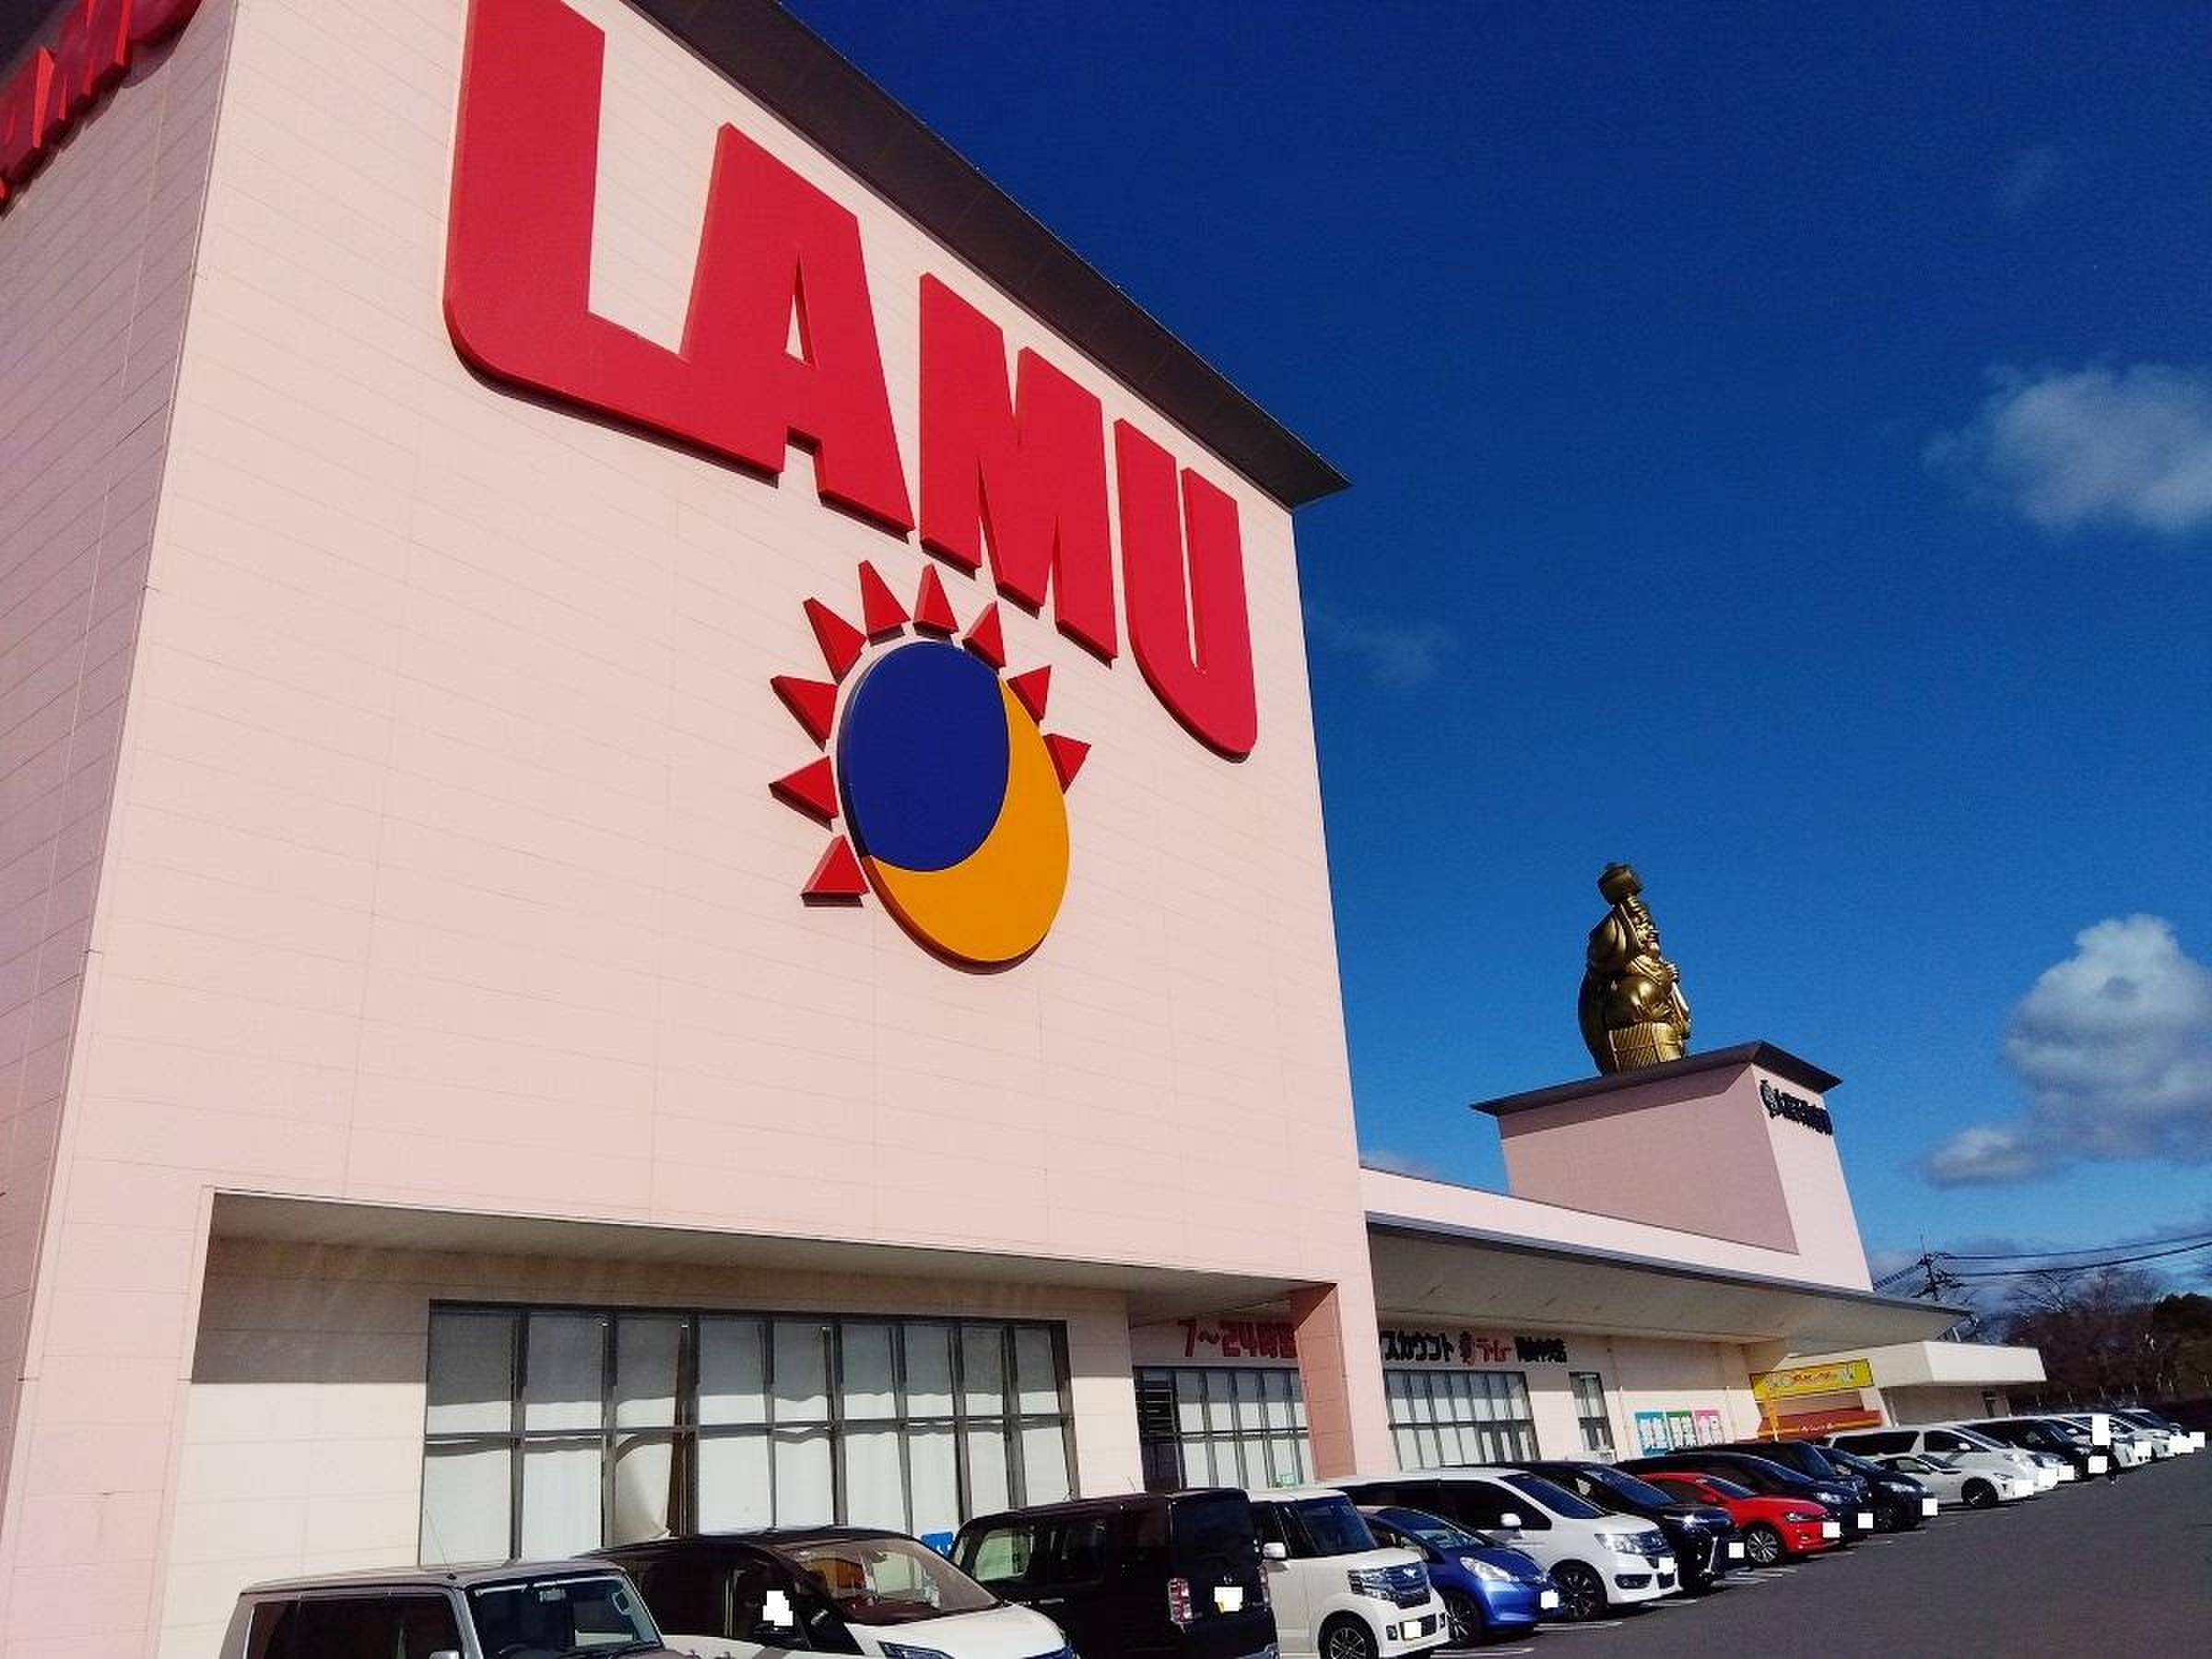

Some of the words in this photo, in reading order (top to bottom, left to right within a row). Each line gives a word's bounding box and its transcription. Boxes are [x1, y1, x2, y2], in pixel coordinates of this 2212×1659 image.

[442, 0, 1257, 763] LAMU
[1379, 1330, 1454, 1362] スカウント
